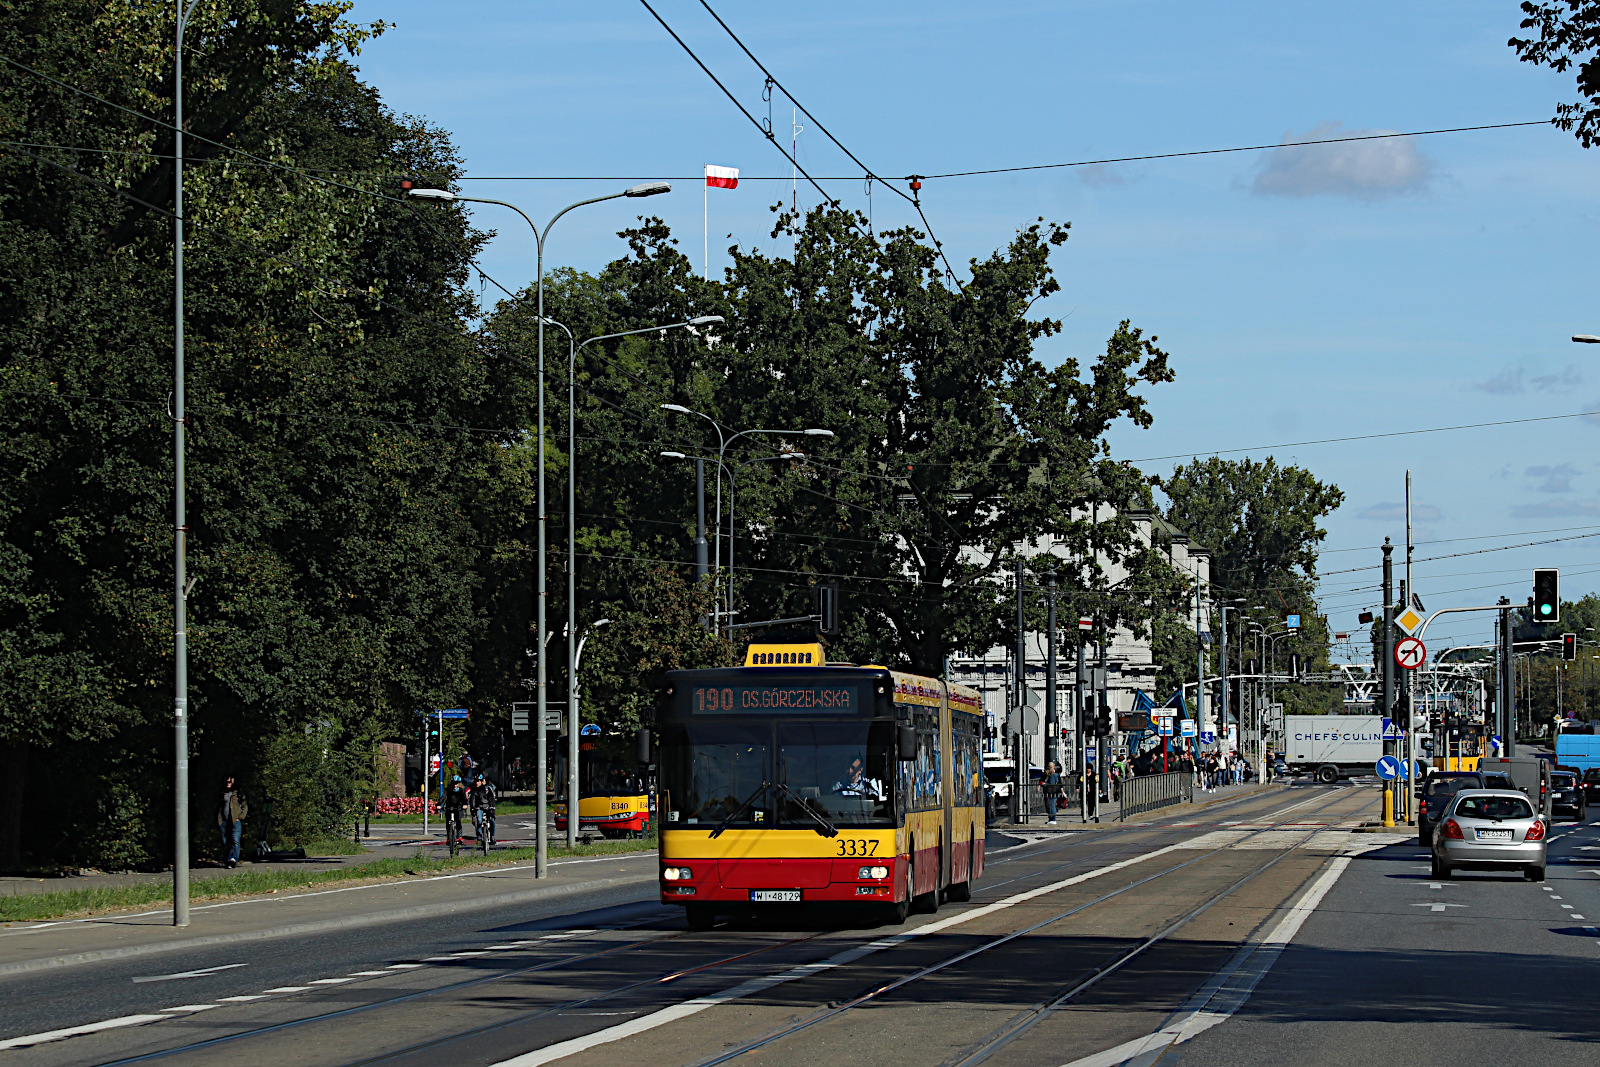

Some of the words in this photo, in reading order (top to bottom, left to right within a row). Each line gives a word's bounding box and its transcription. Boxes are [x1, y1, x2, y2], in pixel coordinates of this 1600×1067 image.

[696, 688, 734, 711] 190
[742, 687, 850, 708] OS.GÓRCZEWSKA
[1294, 733, 1338, 741] CHEFS
[611, 802, 629, 811] 8340
[836, 839, 880, 857] 3337
[772, 892, 801, 901] 48129
